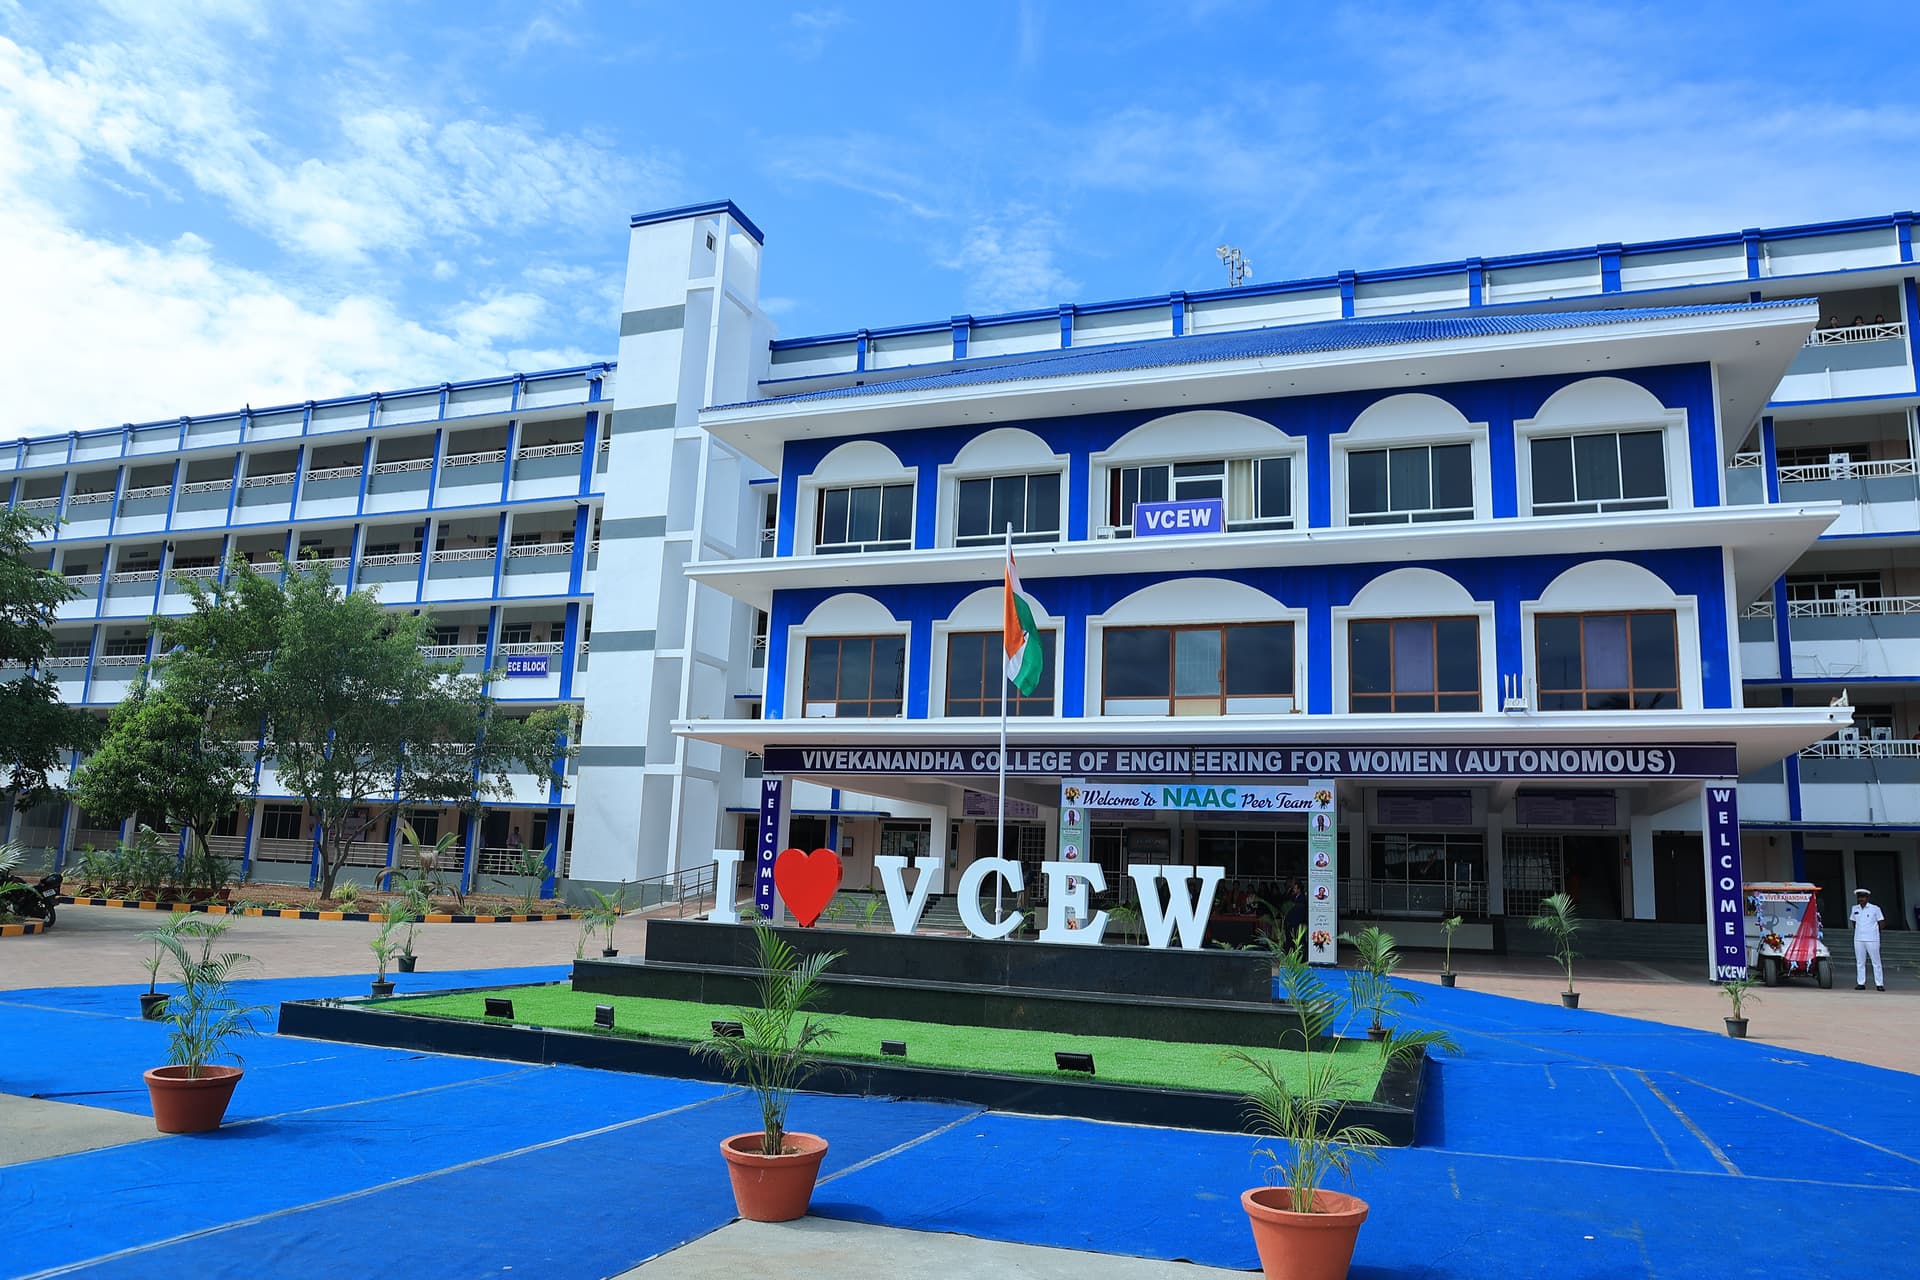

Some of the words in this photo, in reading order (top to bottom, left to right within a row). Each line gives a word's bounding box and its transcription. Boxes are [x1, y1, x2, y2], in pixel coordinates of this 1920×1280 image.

[1145, 508, 1211, 529] VCEW
[507, 661, 521, 672] ECE
[522, 661, 546, 672] BLOCK
[802, 751, 964, 770] VIVEKANANDHA
[971, 752, 1072, 771] COLLEGE
[1079, 751, 1109, 771] OF
[1116, 750, 1283, 773] ENGINEERING
[1290, 751, 1341, 772] FOR
[1348, 751, 1448, 772] WOMEN
[1455, 749, 1676, 774] (AUTONOMOUS)
[1081, 790, 1141, 806] Welcome
[1140, 790, 1157, 806] to
[1162, 787, 1237, 808] NAAC
[1241, 793, 1272, 808] Peer
[1275, 793, 1314, 809] Team
[761, 781, 778, 896] WELCOME
[1713, 789, 1737, 935] WELCOME
[708, 849, 745, 924] I
[874, 855, 1225, 949] VCEW
[1724, 945, 1738, 955] TO
[1717, 965, 1746, 979] VCEW
